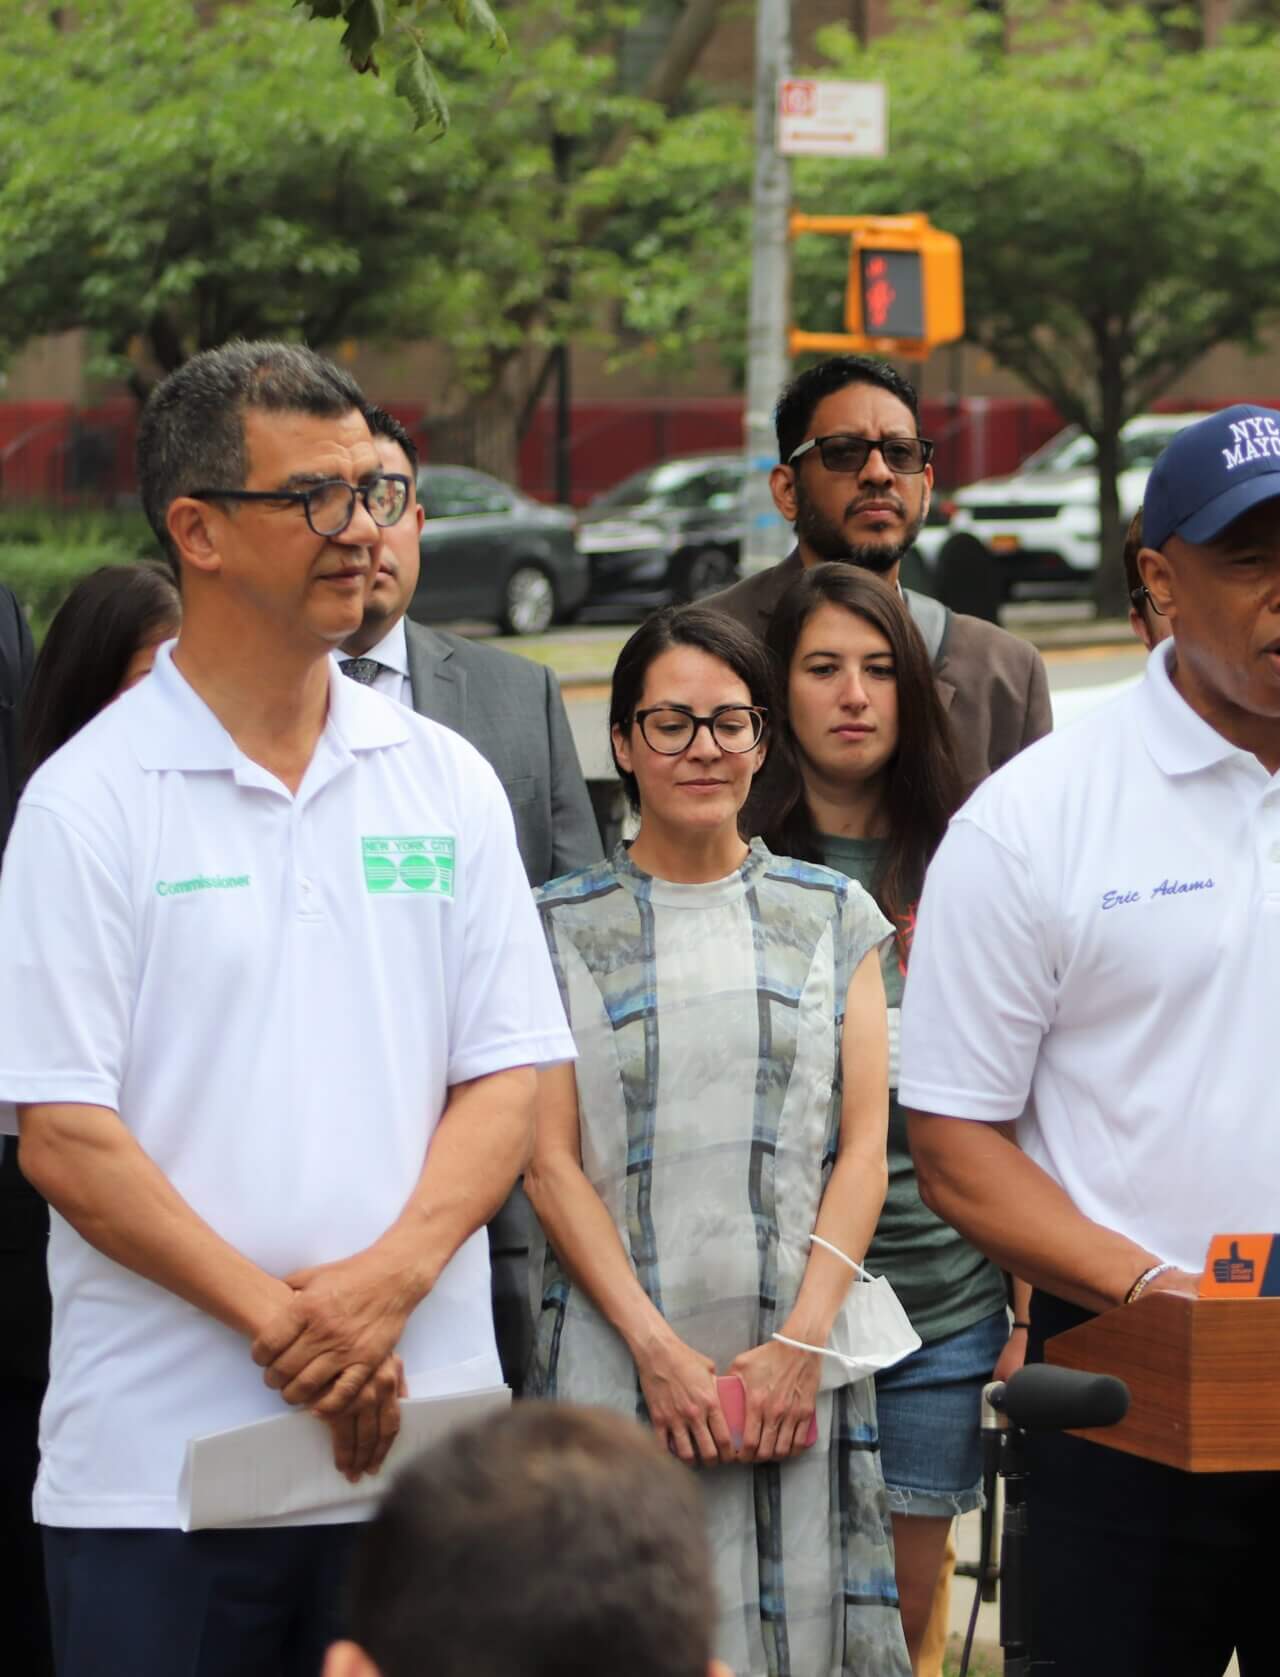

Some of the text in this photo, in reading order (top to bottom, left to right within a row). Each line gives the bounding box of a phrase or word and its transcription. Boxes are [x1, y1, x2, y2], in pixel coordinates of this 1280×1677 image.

[1228, 416, 1280, 443] NYC
[391, 840, 424, 851] YORK
[155, 875, 251, 897] Commissioner
[1101, 878, 1216, 910] Eric Adams
